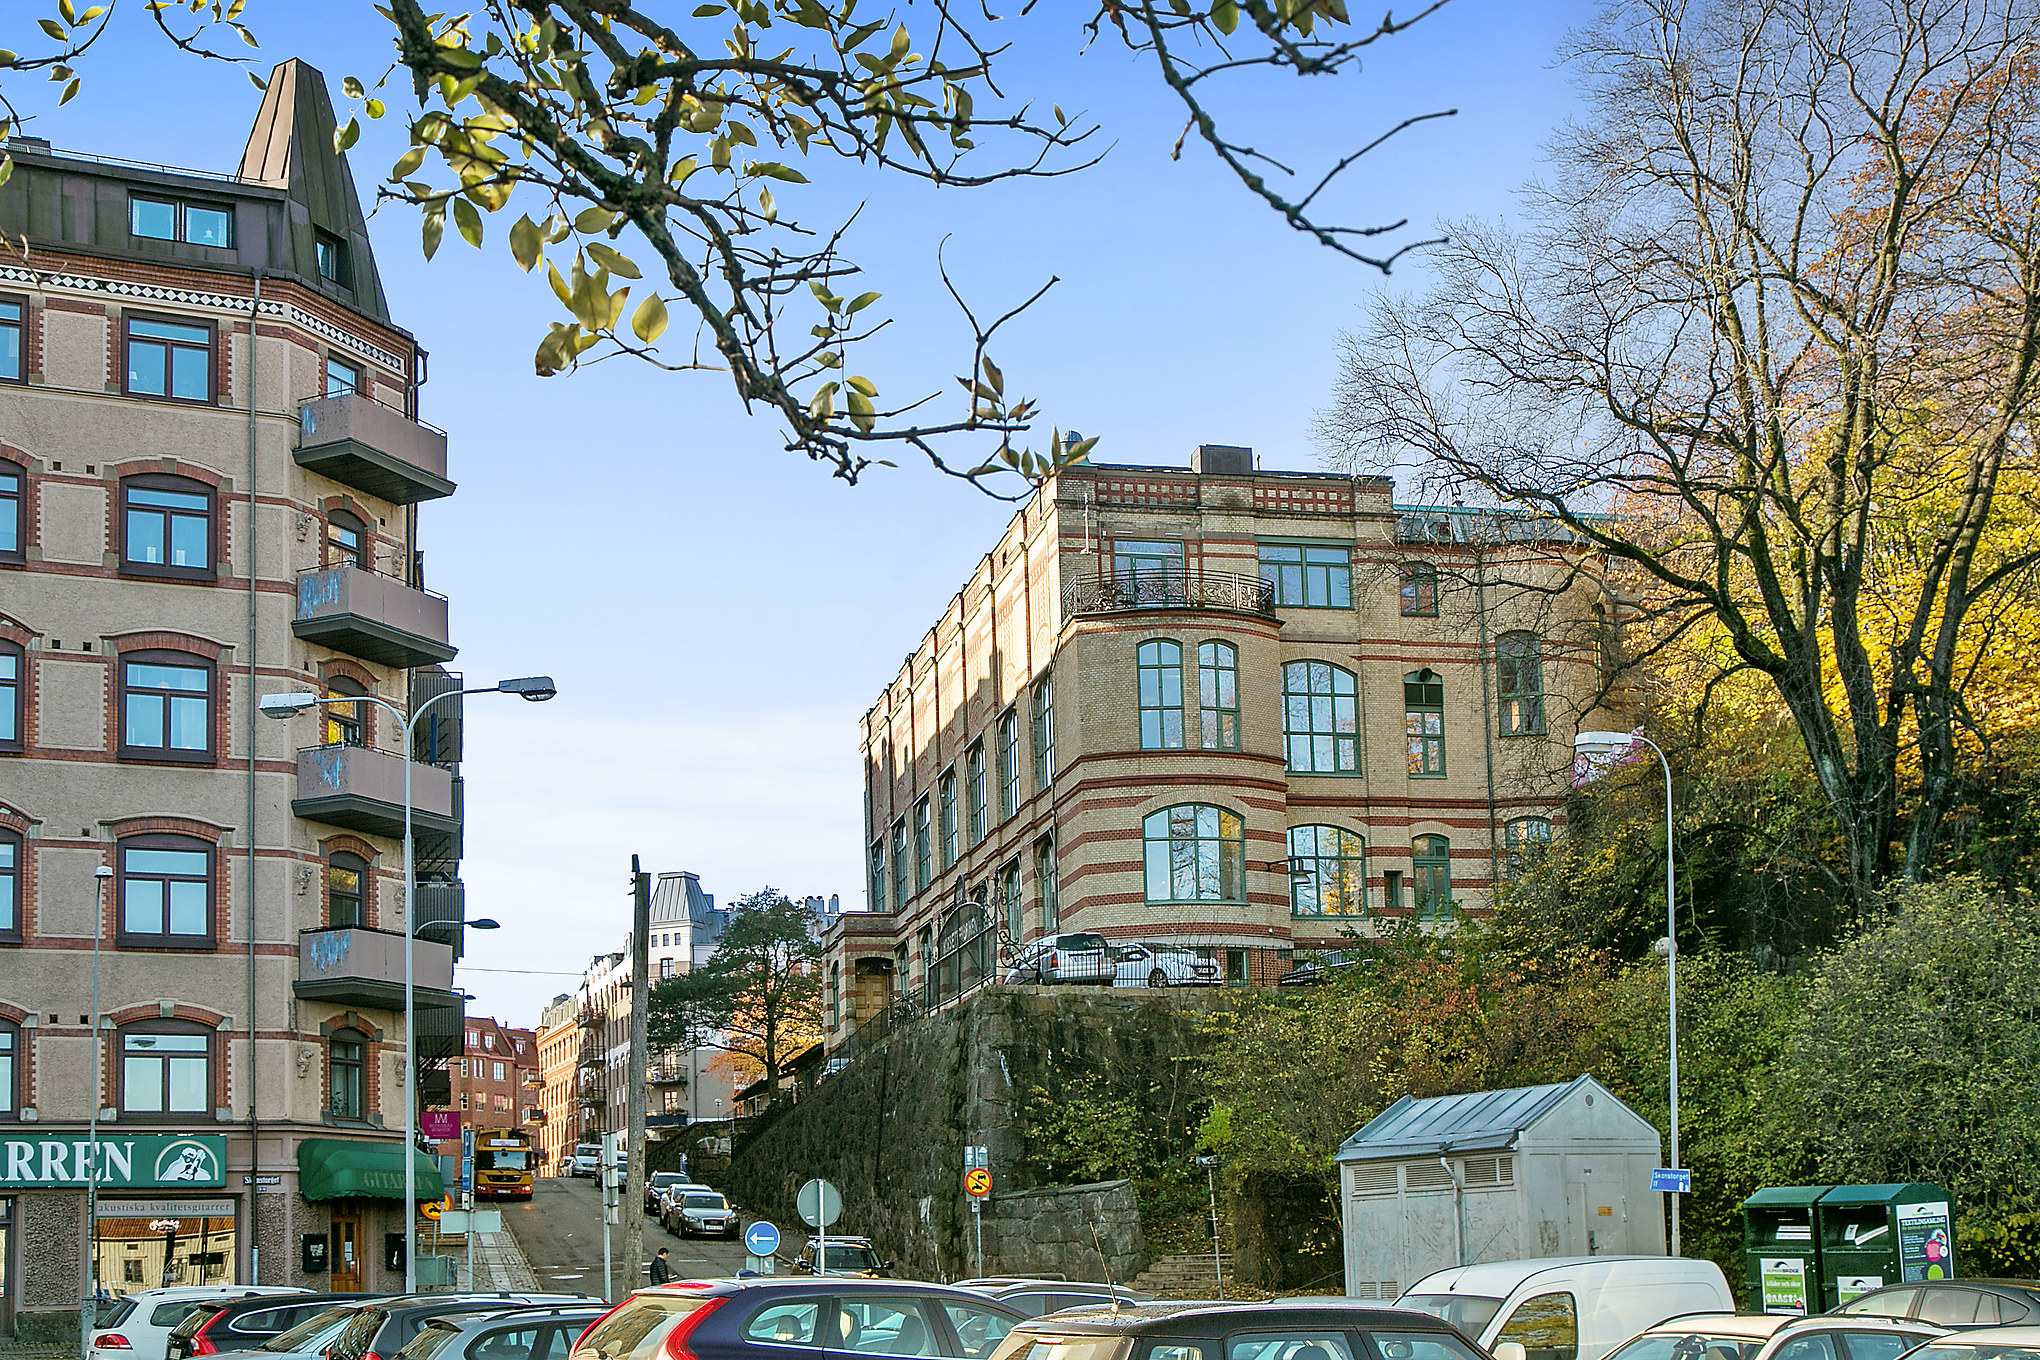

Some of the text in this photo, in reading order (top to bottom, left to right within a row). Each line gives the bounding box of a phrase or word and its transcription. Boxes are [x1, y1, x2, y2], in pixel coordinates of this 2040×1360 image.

[0, 1141, 136, 1182] RREN
[1654, 1171, 1689, 1181] Skanstorget
[98, 1202, 230, 1213] akustiska kvalitetsgitarrer
